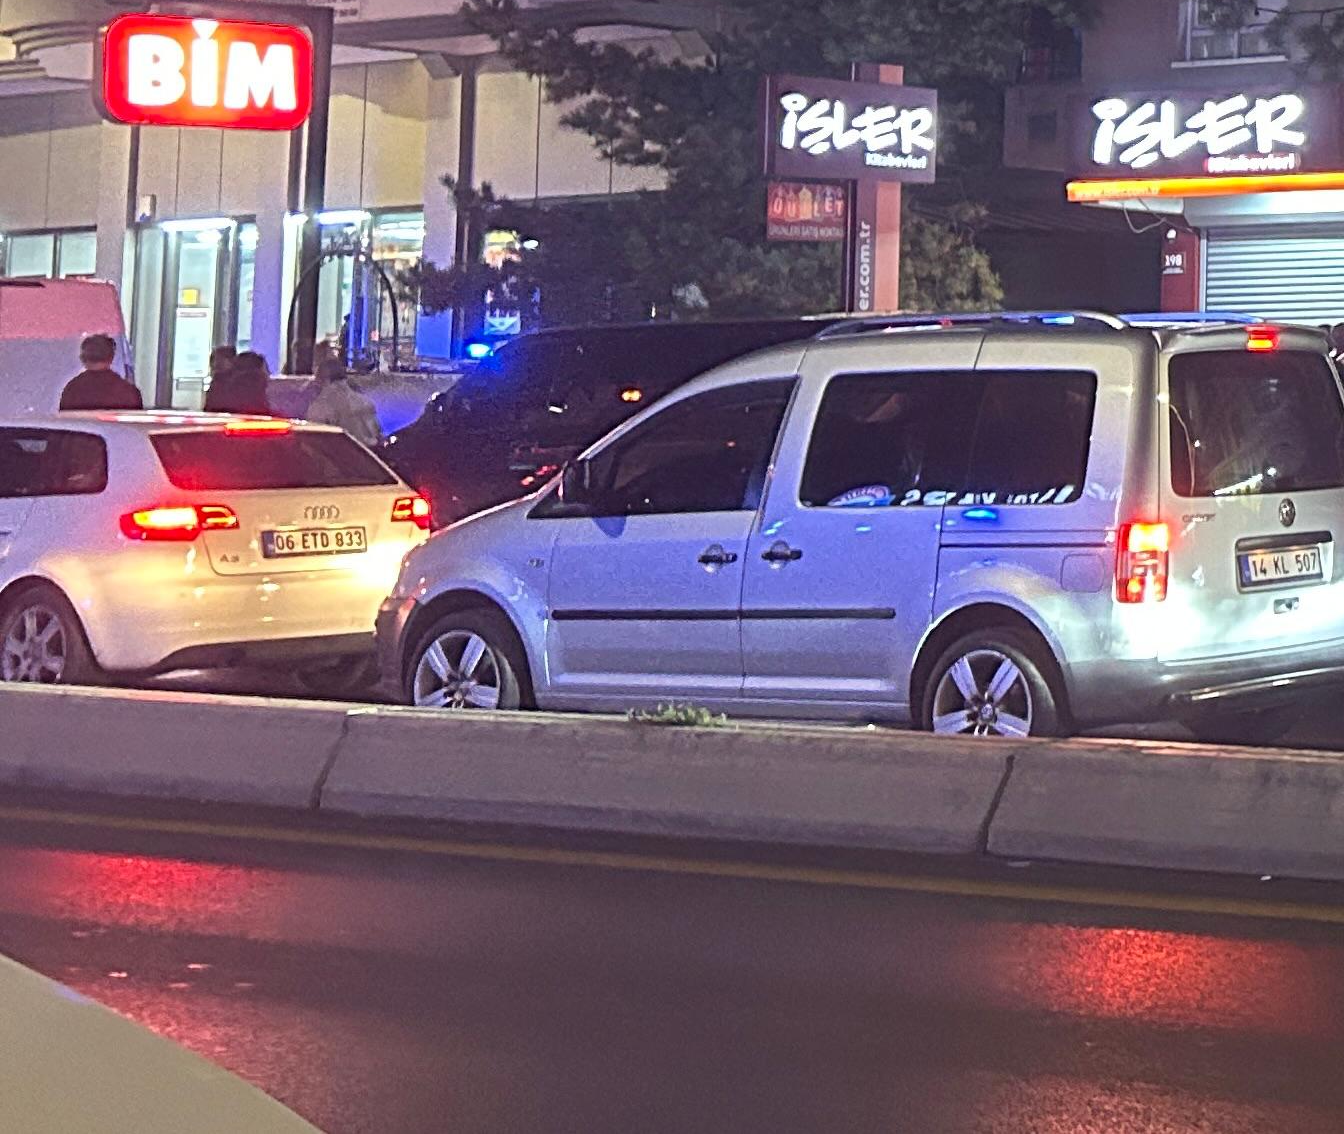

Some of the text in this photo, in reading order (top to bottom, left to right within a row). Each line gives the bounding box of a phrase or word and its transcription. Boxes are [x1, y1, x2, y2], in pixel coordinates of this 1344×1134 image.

[127, 19, 298, 110] BİM
[275, 530, 363, 551] 06 ETD 833
[1252, 552, 1317, 577] 14 KL 507
